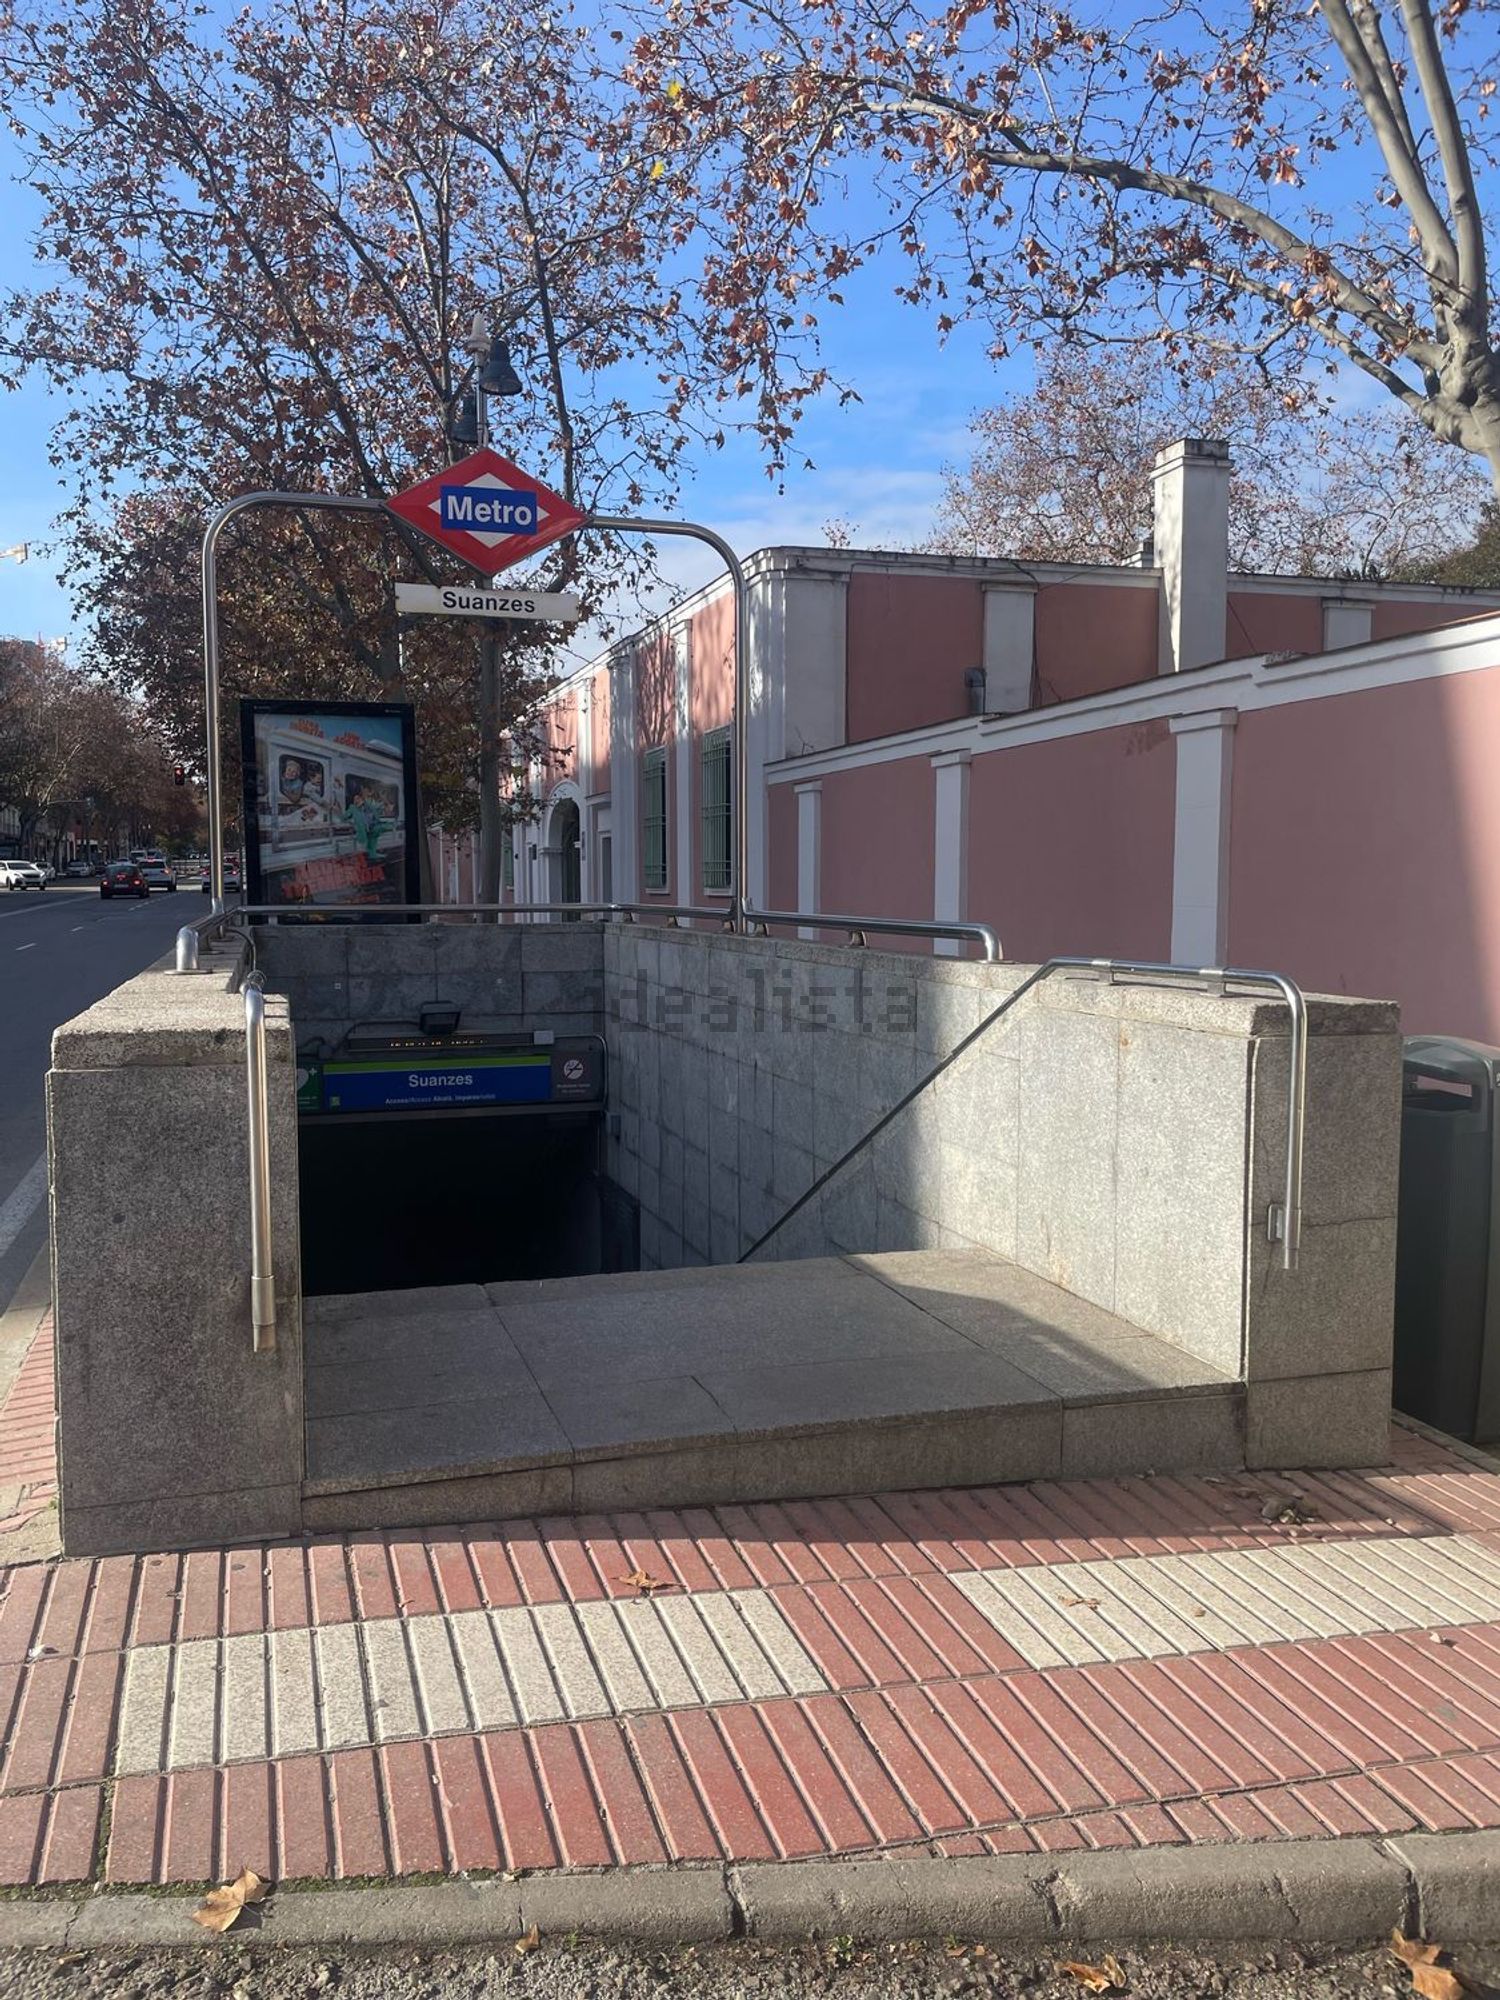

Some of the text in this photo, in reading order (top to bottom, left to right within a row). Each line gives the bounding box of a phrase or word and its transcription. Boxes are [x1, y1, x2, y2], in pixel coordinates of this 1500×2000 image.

[447, 495, 533, 526] Metro
[442, 590, 536, 613] Suanzes
[408, 1073, 474, 1088] Suanzes
